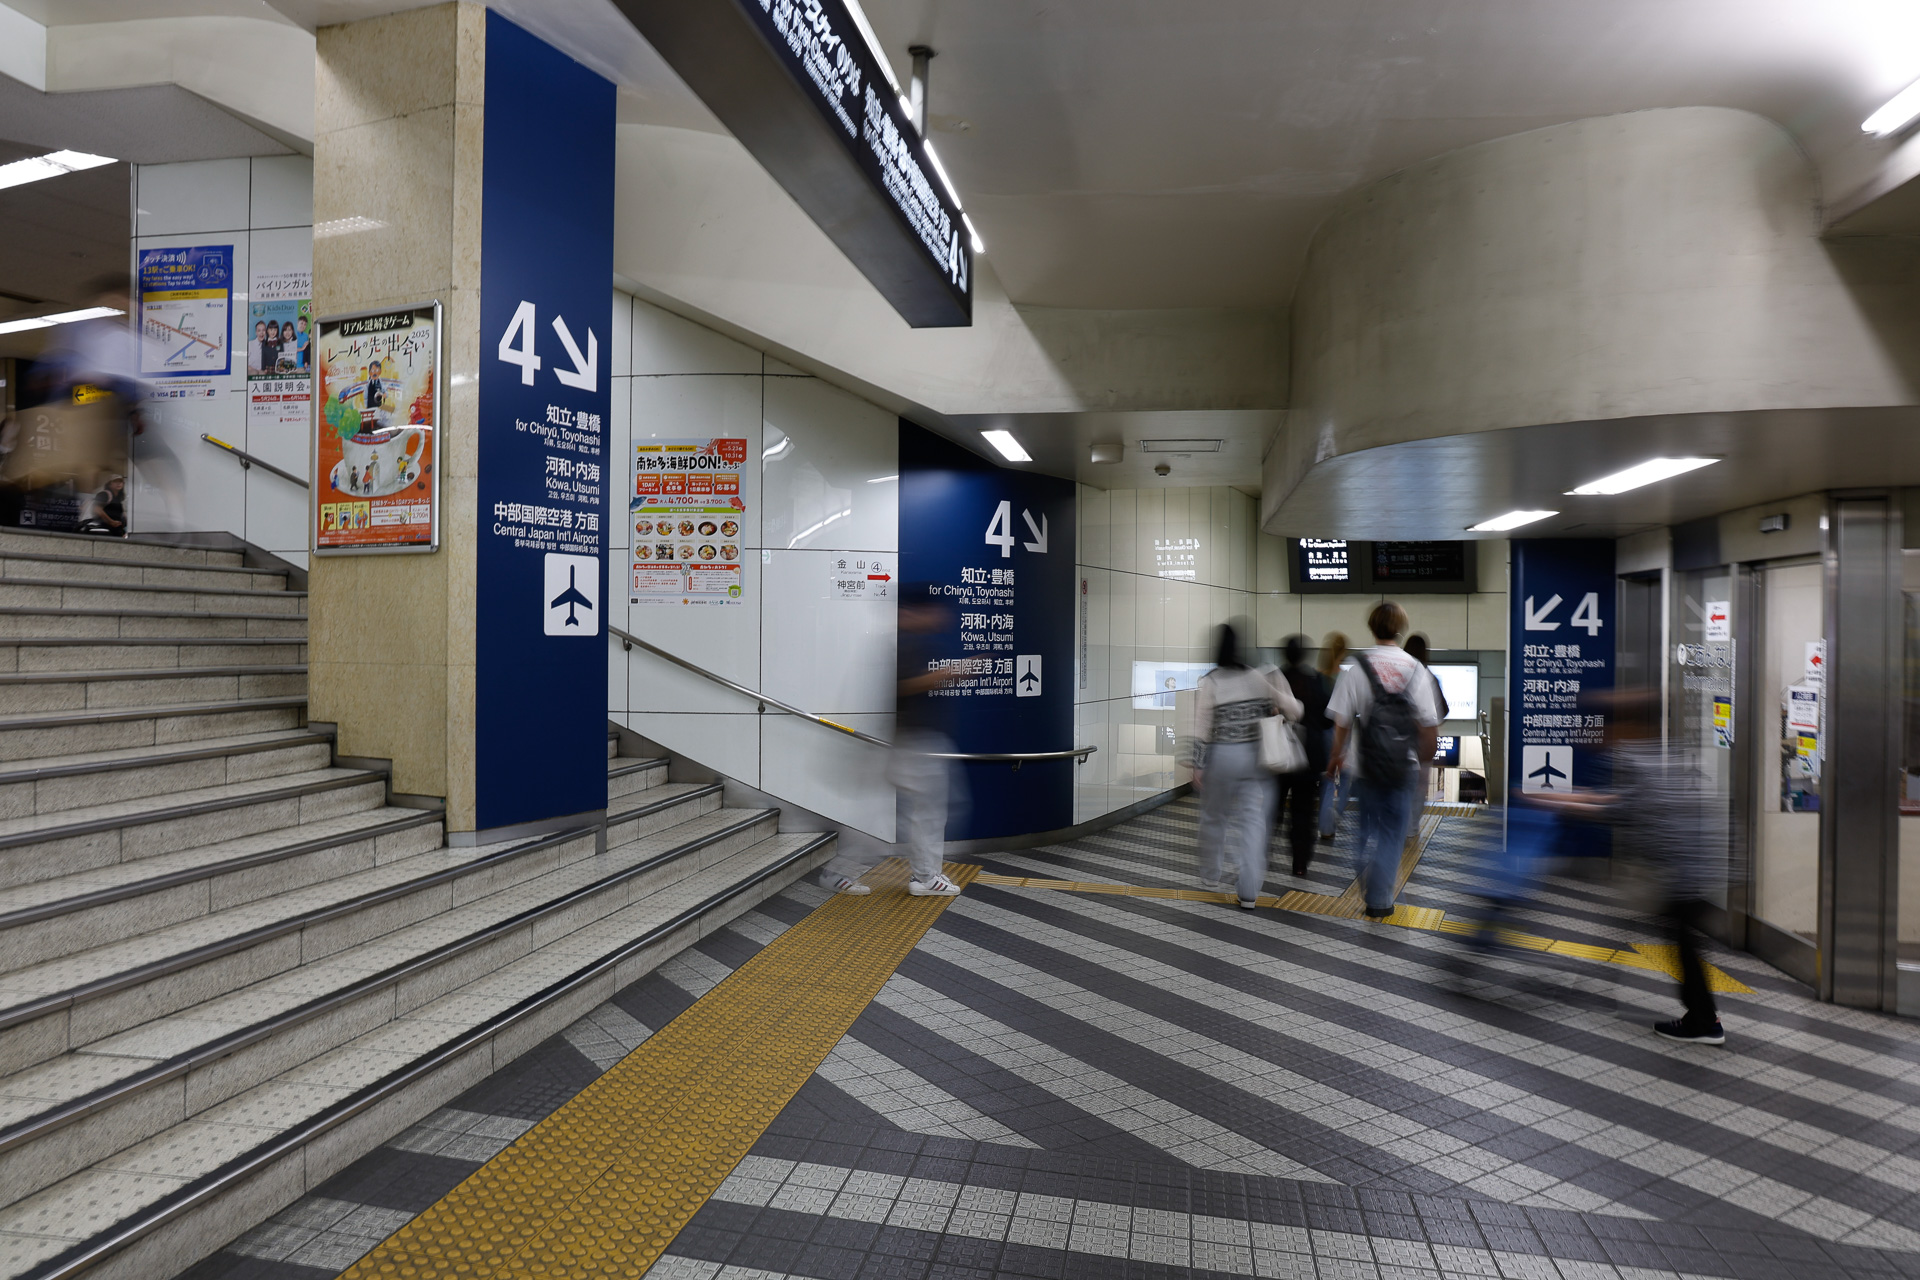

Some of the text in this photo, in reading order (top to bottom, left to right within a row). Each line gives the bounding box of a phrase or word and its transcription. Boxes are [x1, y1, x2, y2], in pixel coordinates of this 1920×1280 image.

[949, 230, 959, 284] 4
[256, 279, 312, 290] バイリンガル
[344, 314, 410, 336] リアル謎解きゲーム
[412, 330, 430, 340] 2025
[498, 300, 541, 386] 4
[328, 334, 424, 367] レールの先の出会い
[252, 381, 304, 393] 入園説明会
[546, 404, 600, 433] 知立・豊橋
[516, 418, 600, 446] for Chiryū, Toyohashi
[546, 455, 600, 482] 河和・内海
[636, 455, 721, 470] 南知多海鮮DON!
[546, 477, 600, 495] Kōwa, Utsumi
[494, 501, 599, 532] 中部国際空港 方面
[494, 522, 526, 537] Central
[528, 526, 554, 541] Japan
[572, 532, 599, 546] Airport
[985, 500, 1015, 558] 4
[1300, 538, 1307, 548] 4
[961, 566, 1014, 586] 知立・豊橋
[837, 580, 866, 590] 神宮前
[929, 585, 1014, 598] for Chiryū, Toyohashi
[961, 613, 1014, 630] 河和・内海
[1571, 592, 1603, 636] 4
[961, 632, 1014, 643] Kōwa, Utsumi
[1524, 644, 1580, 658] 知立・豊橋
[928, 658, 1014, 675] 中部国際空港 方面
[1524, 659, 1535, 667] for
[1565, 659, 1605, 668] Toyohashi
[932, 678, 955, 688] entral
[956, 678, 978, 689] Japan
[992, 676, 1013, 688] Airport
[1523, 679, 1580, 693] 河和・内海
[1548, 694, 1577, 702] Utsumi
[1523, 714, 1604, 728] 中部国際空港 方面
[1522, 728, 1546, 737] Central
[1548, 729, 1568, 738] Japan
[1582, 729, 1604, 738] Airport
